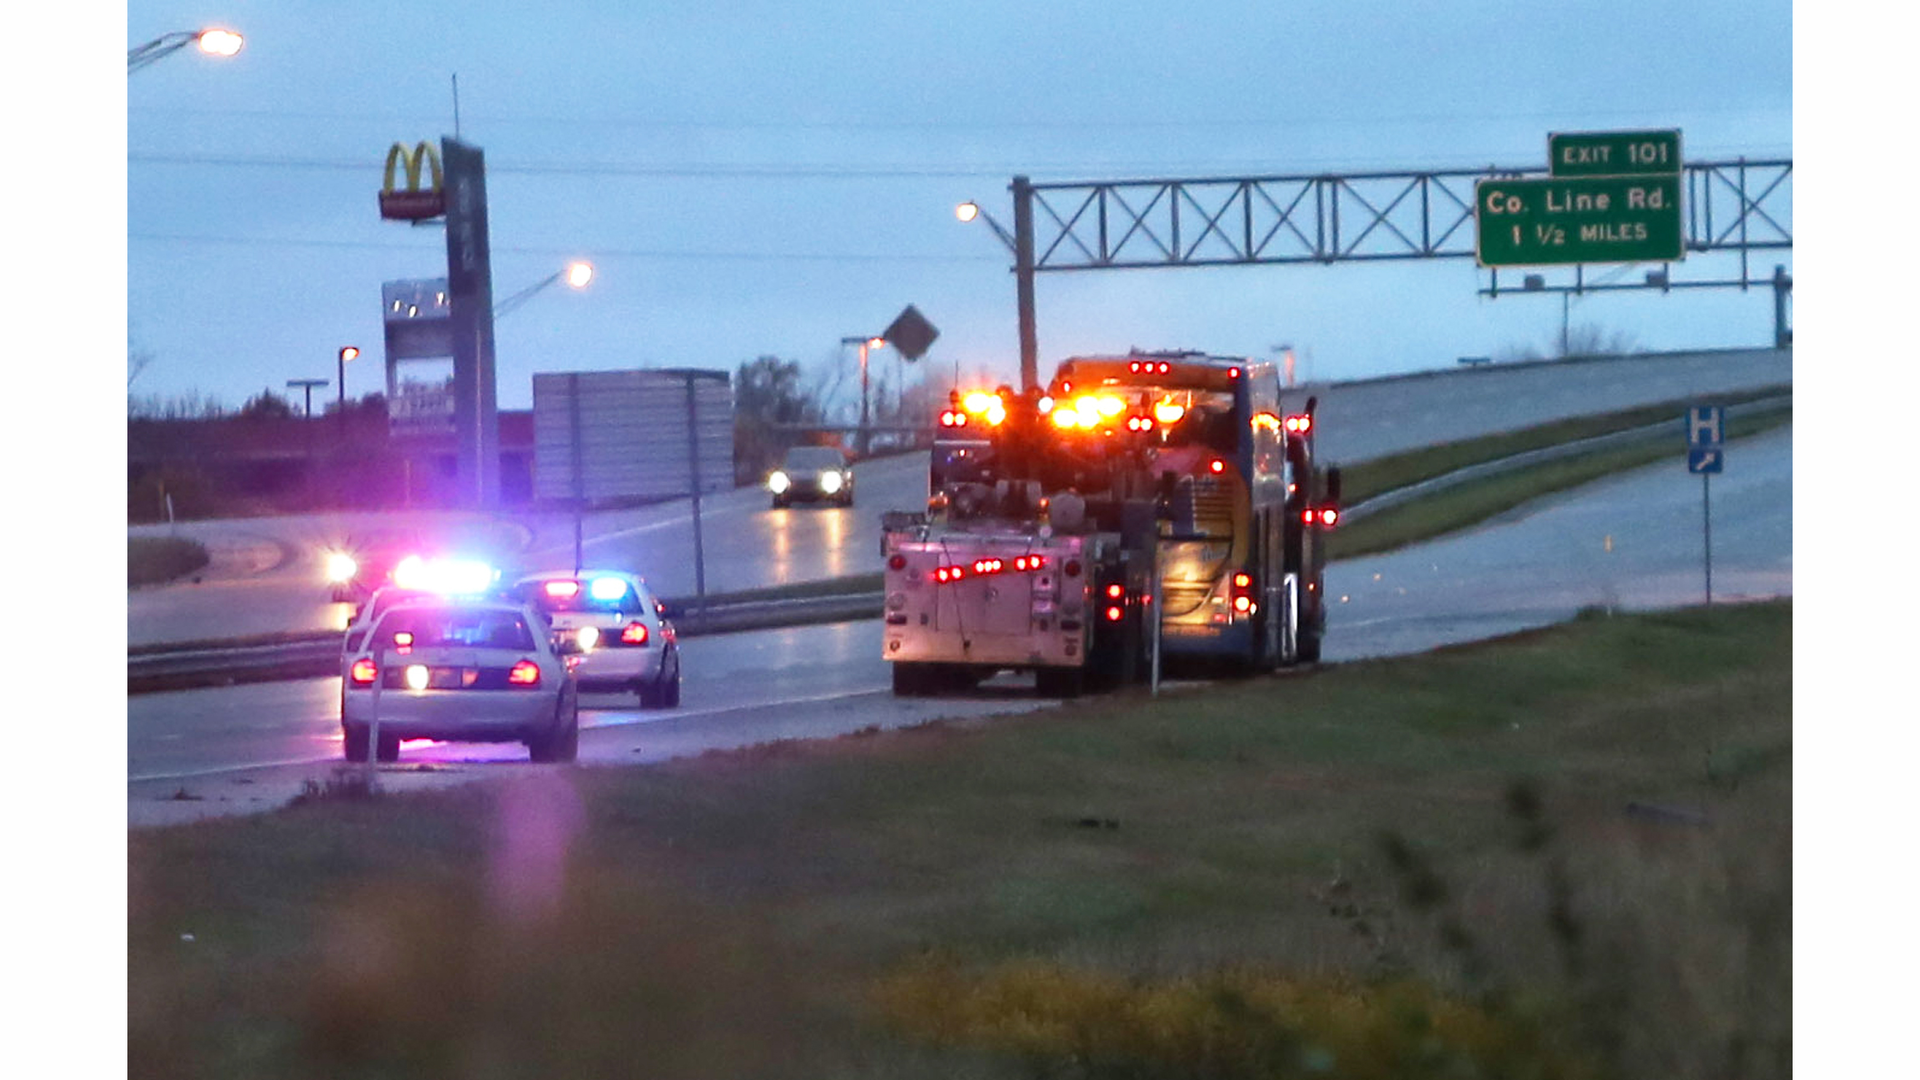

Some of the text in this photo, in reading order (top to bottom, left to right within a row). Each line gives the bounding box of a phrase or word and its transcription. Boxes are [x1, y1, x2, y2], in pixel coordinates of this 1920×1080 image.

[1563, 142, 1667, 163] EXIT 101
[1486, 187, 1672, 213] Co. Line Rd.
[1512, 224, 1521, 246] 1
[1580, 222, 1647, 241] MILES
[1690, 406, 1719, 442] H
